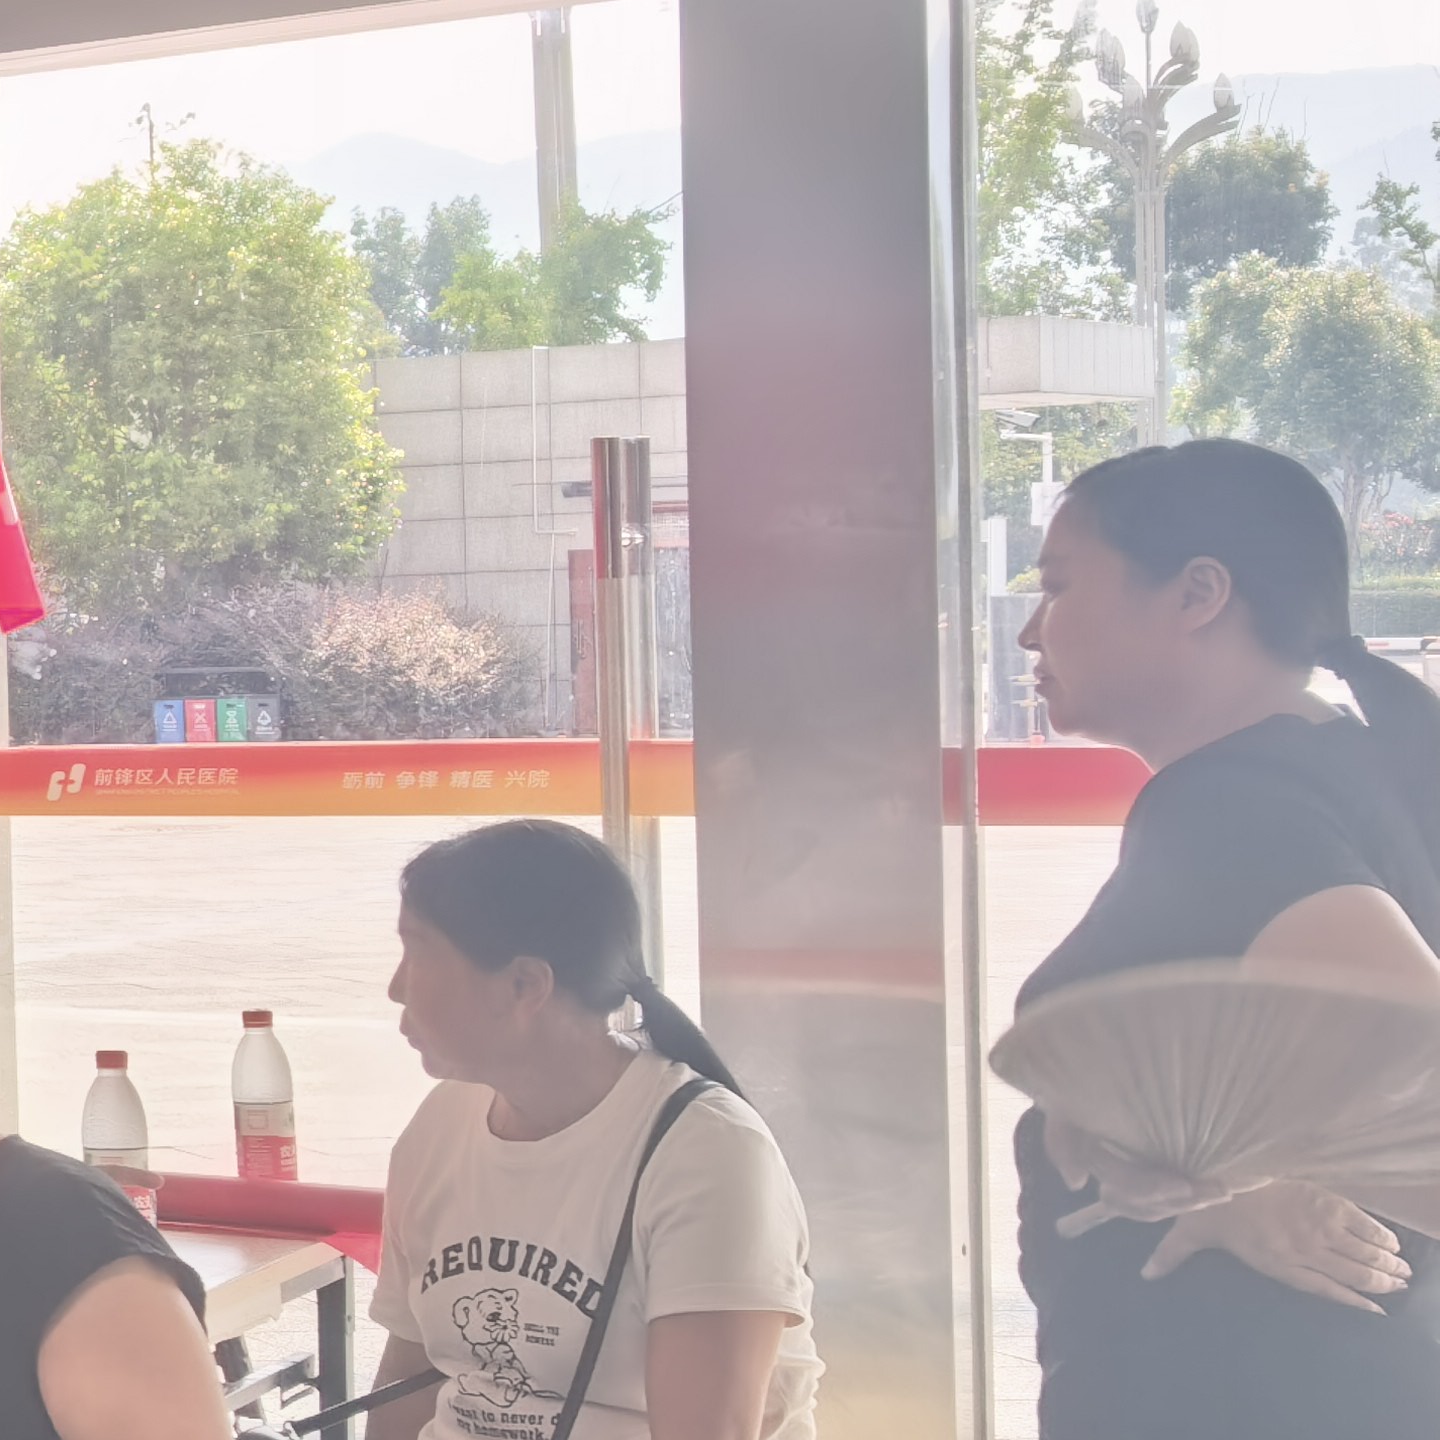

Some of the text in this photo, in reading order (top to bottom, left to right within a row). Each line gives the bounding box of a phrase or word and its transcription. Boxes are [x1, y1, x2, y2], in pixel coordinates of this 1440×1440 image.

[94, 767, 240, 786] 前锋区人民医院
[395, 770, 440, 790] 争锋
[449, 769, 495, 789] 精医
[504, 768, 551, 789] 兴院
[420, 1235, 606, 1321] REQUIRED
[481, 1410, 496, 1424] to
[500, 1412, 545, 1427] never
